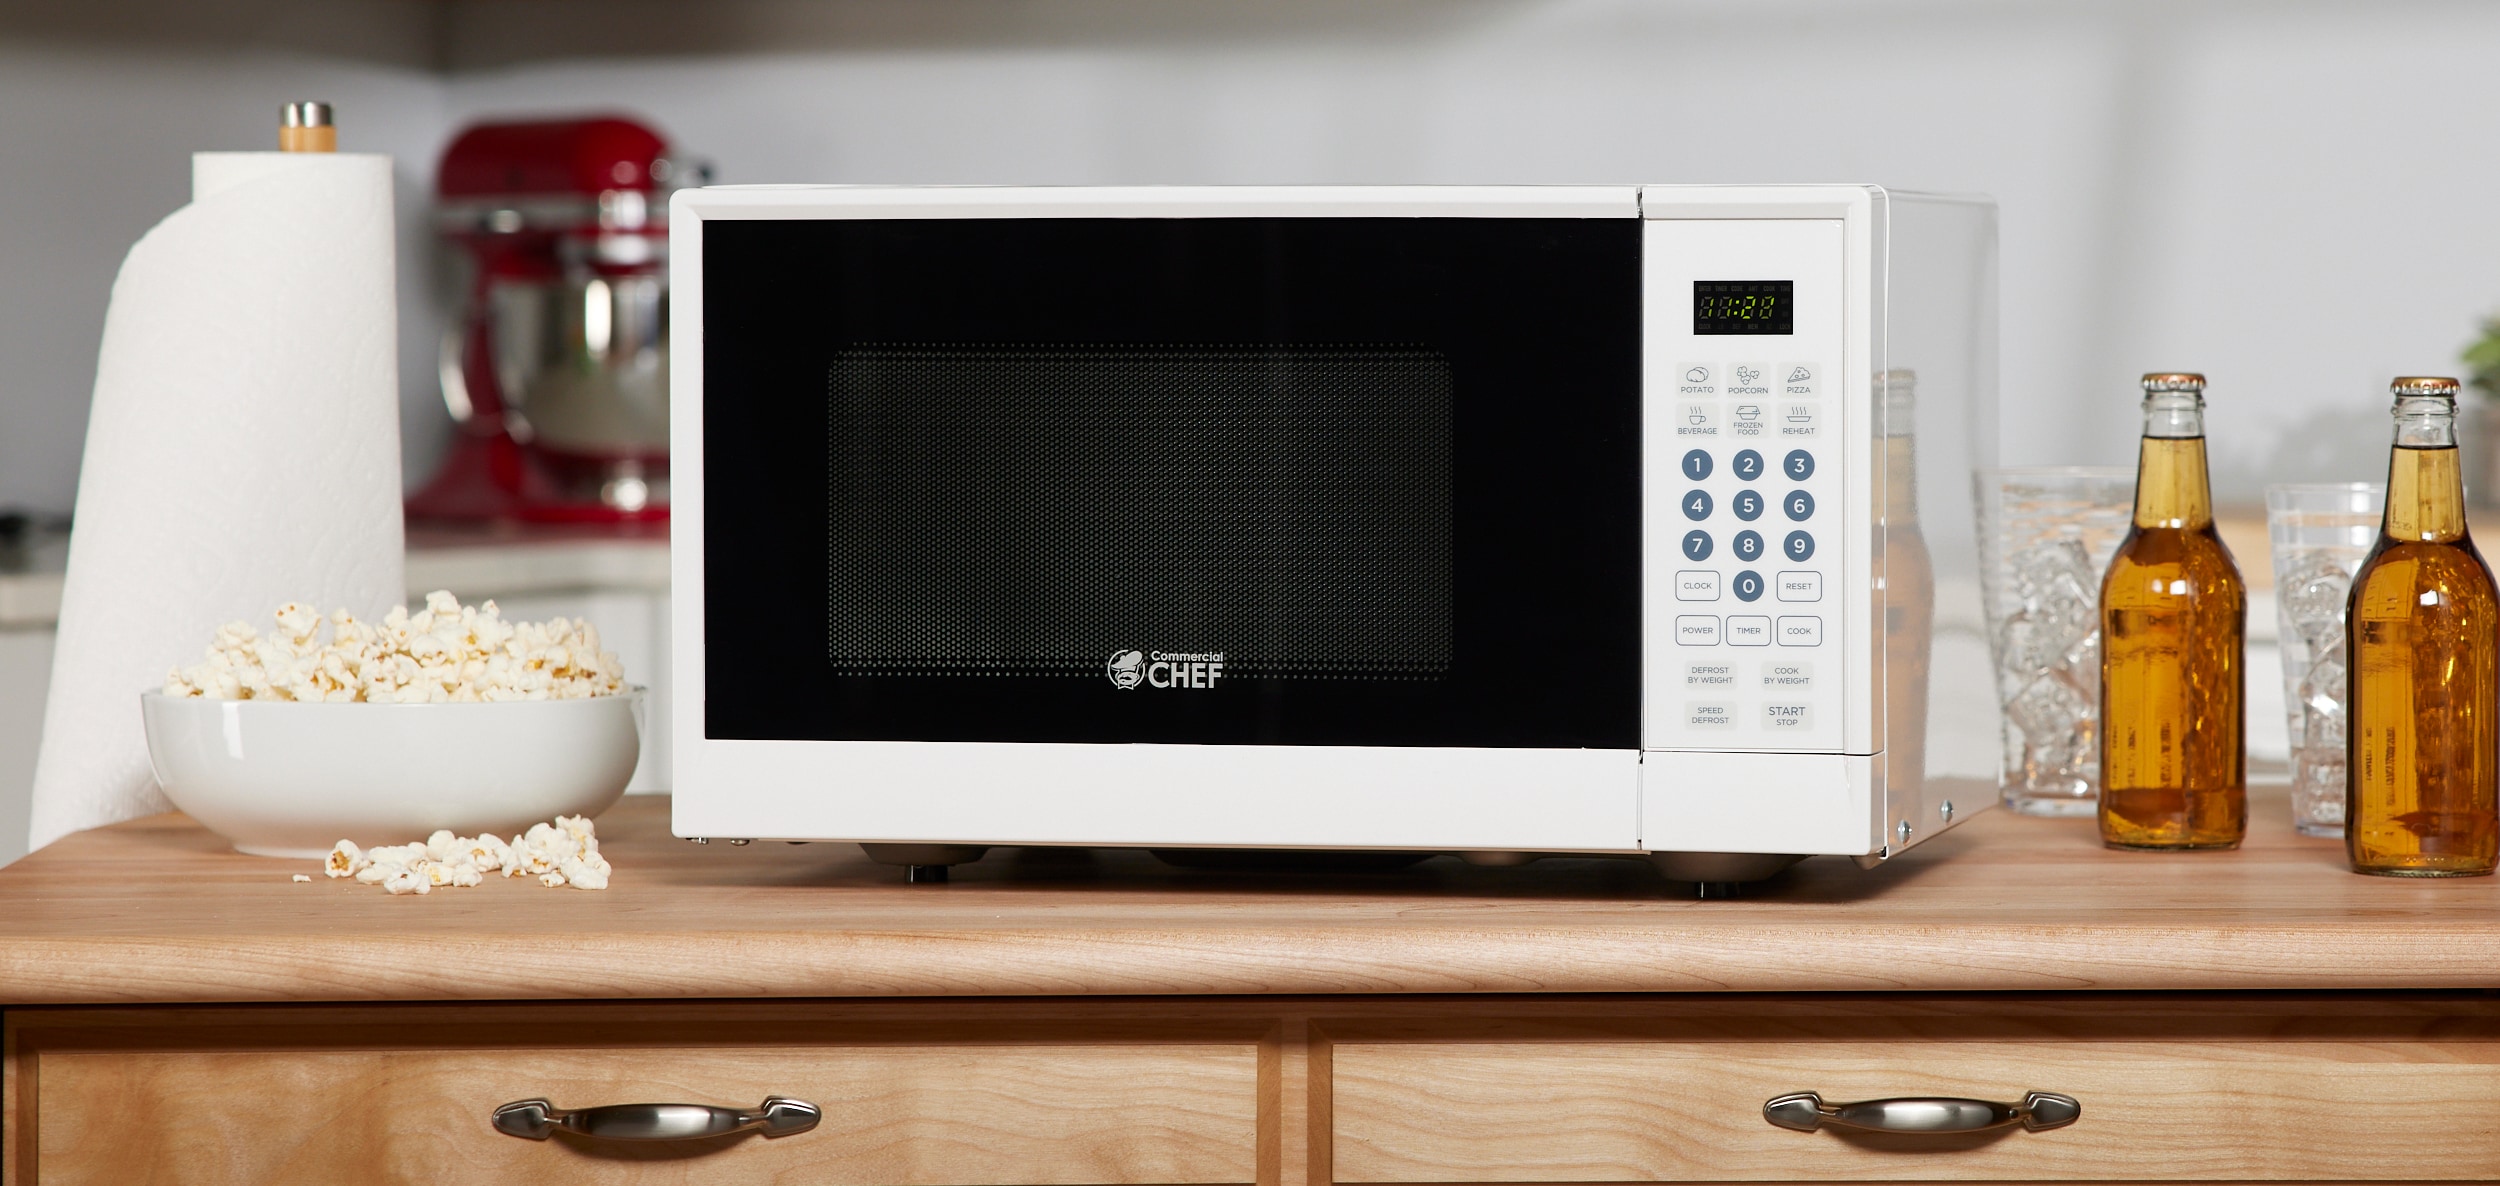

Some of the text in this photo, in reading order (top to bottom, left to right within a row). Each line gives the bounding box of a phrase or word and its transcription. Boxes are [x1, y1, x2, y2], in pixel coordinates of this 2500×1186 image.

[1694, 458, 1700, 472] 1
[1743, 458, 1754, 472] 2
[1795, 459, 1804, 473] 3
[1692, 498, 1703, 512] 4
[1744, 498, 1754, 512] 5
[1794, 499, 1805, 513] 6
[1693, 538, 1703, 552] 7
[1743, 538, 1754, 552] 8
[1794, 539, 1805, 553] 9
[1743, 579, 1755, 593] 0
[1151, 650, 1224, 662] Commercial
[1148, 662, 1224, 688] CHEF
[1769, 707, 1805, 716] START
